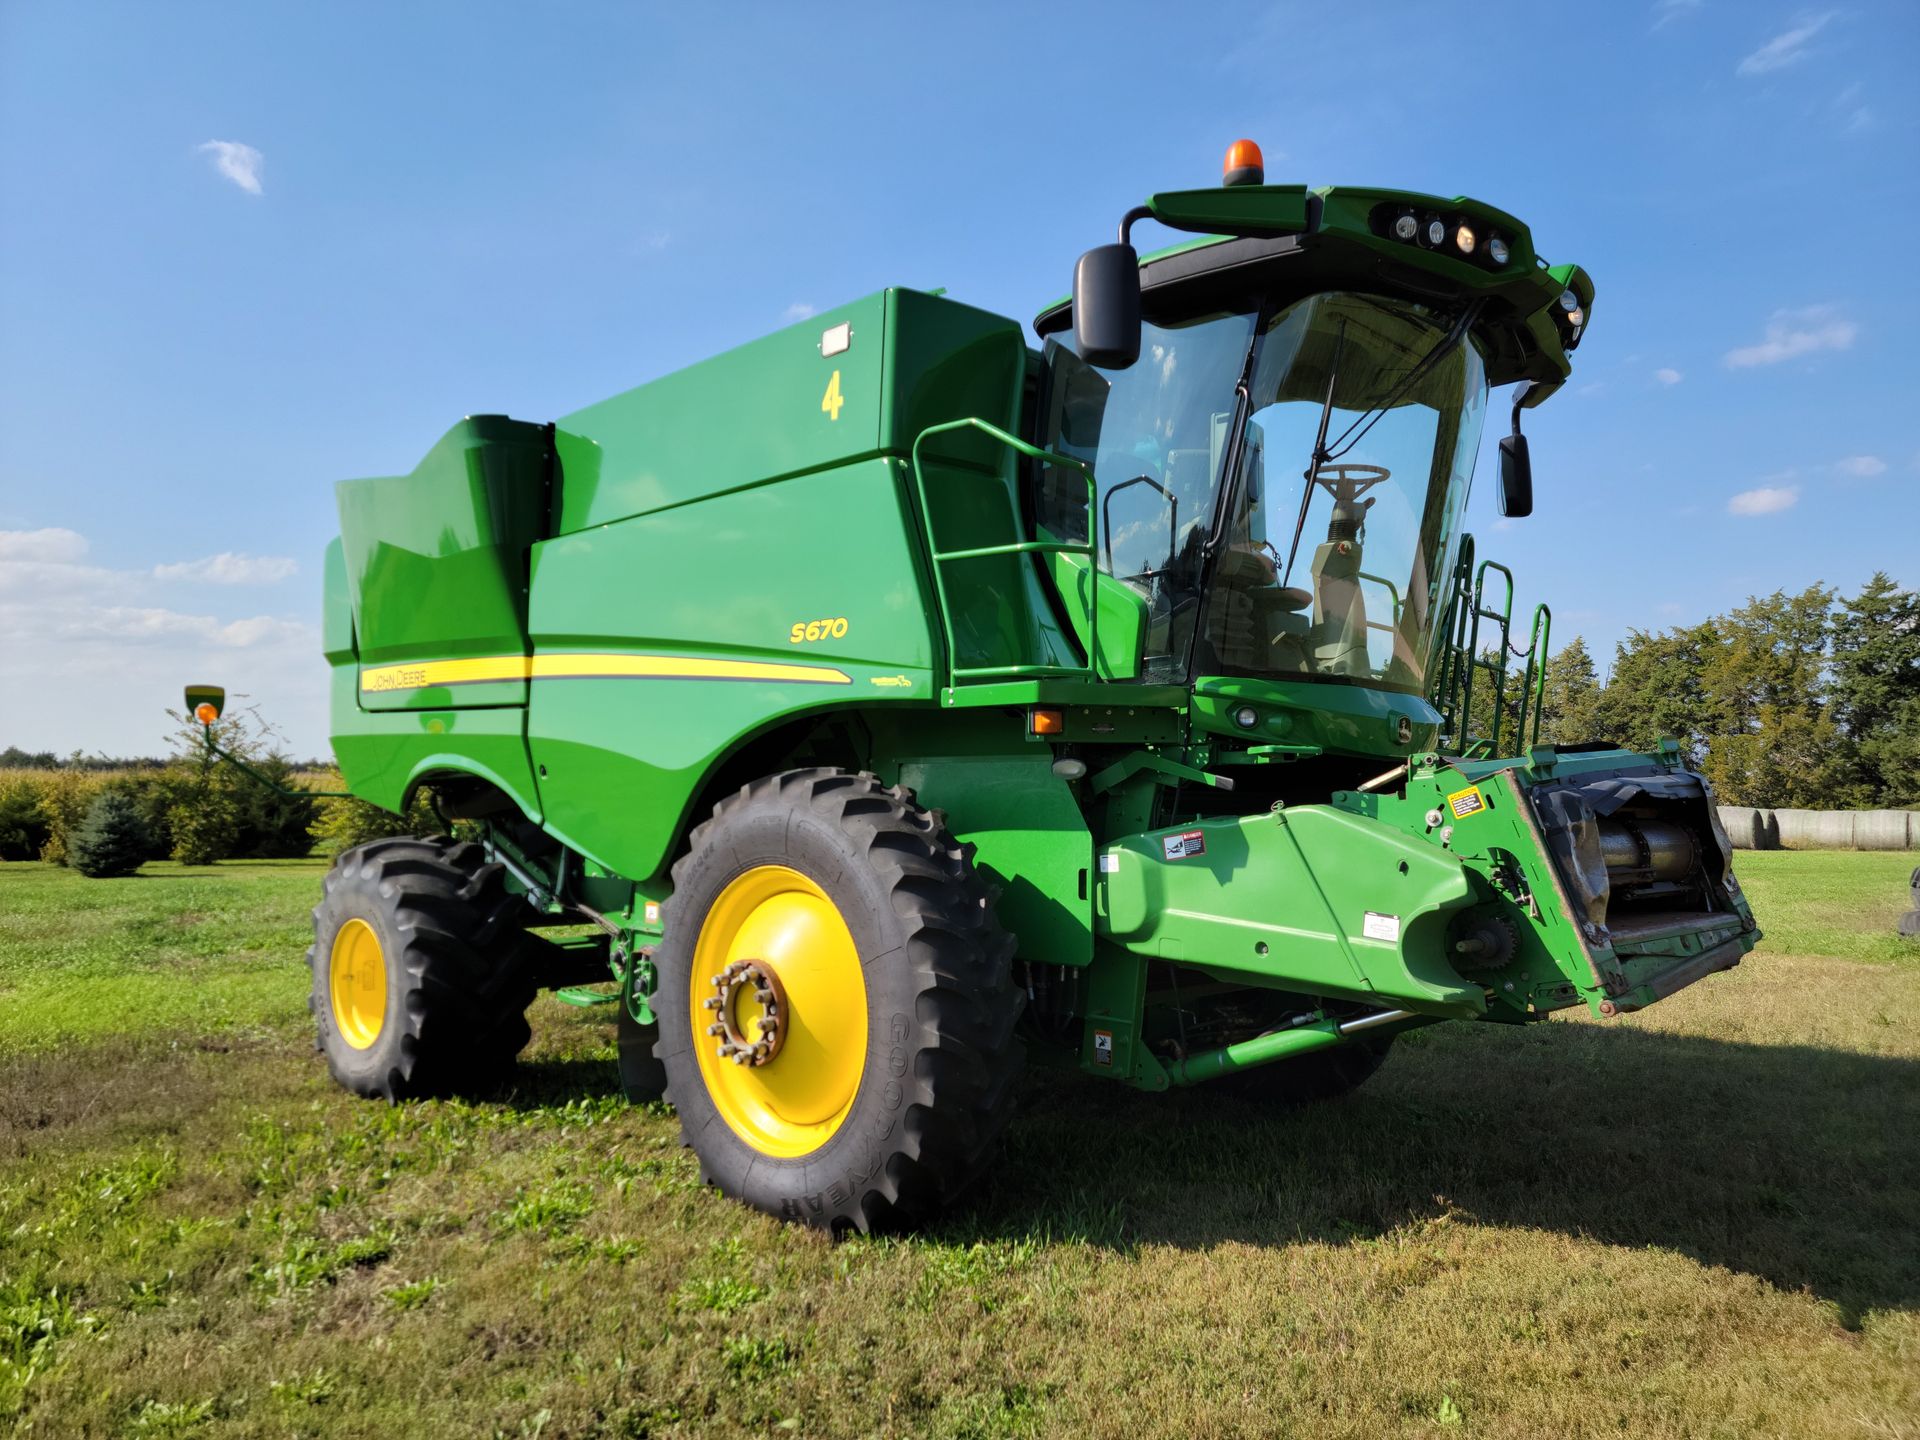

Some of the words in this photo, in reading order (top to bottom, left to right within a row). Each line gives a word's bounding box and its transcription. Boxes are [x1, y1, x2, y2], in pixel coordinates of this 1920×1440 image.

[821, 369, 844, 421] 4
[789, 616, 849, 644] S670
[397, 670, 427, 687] DEERE
